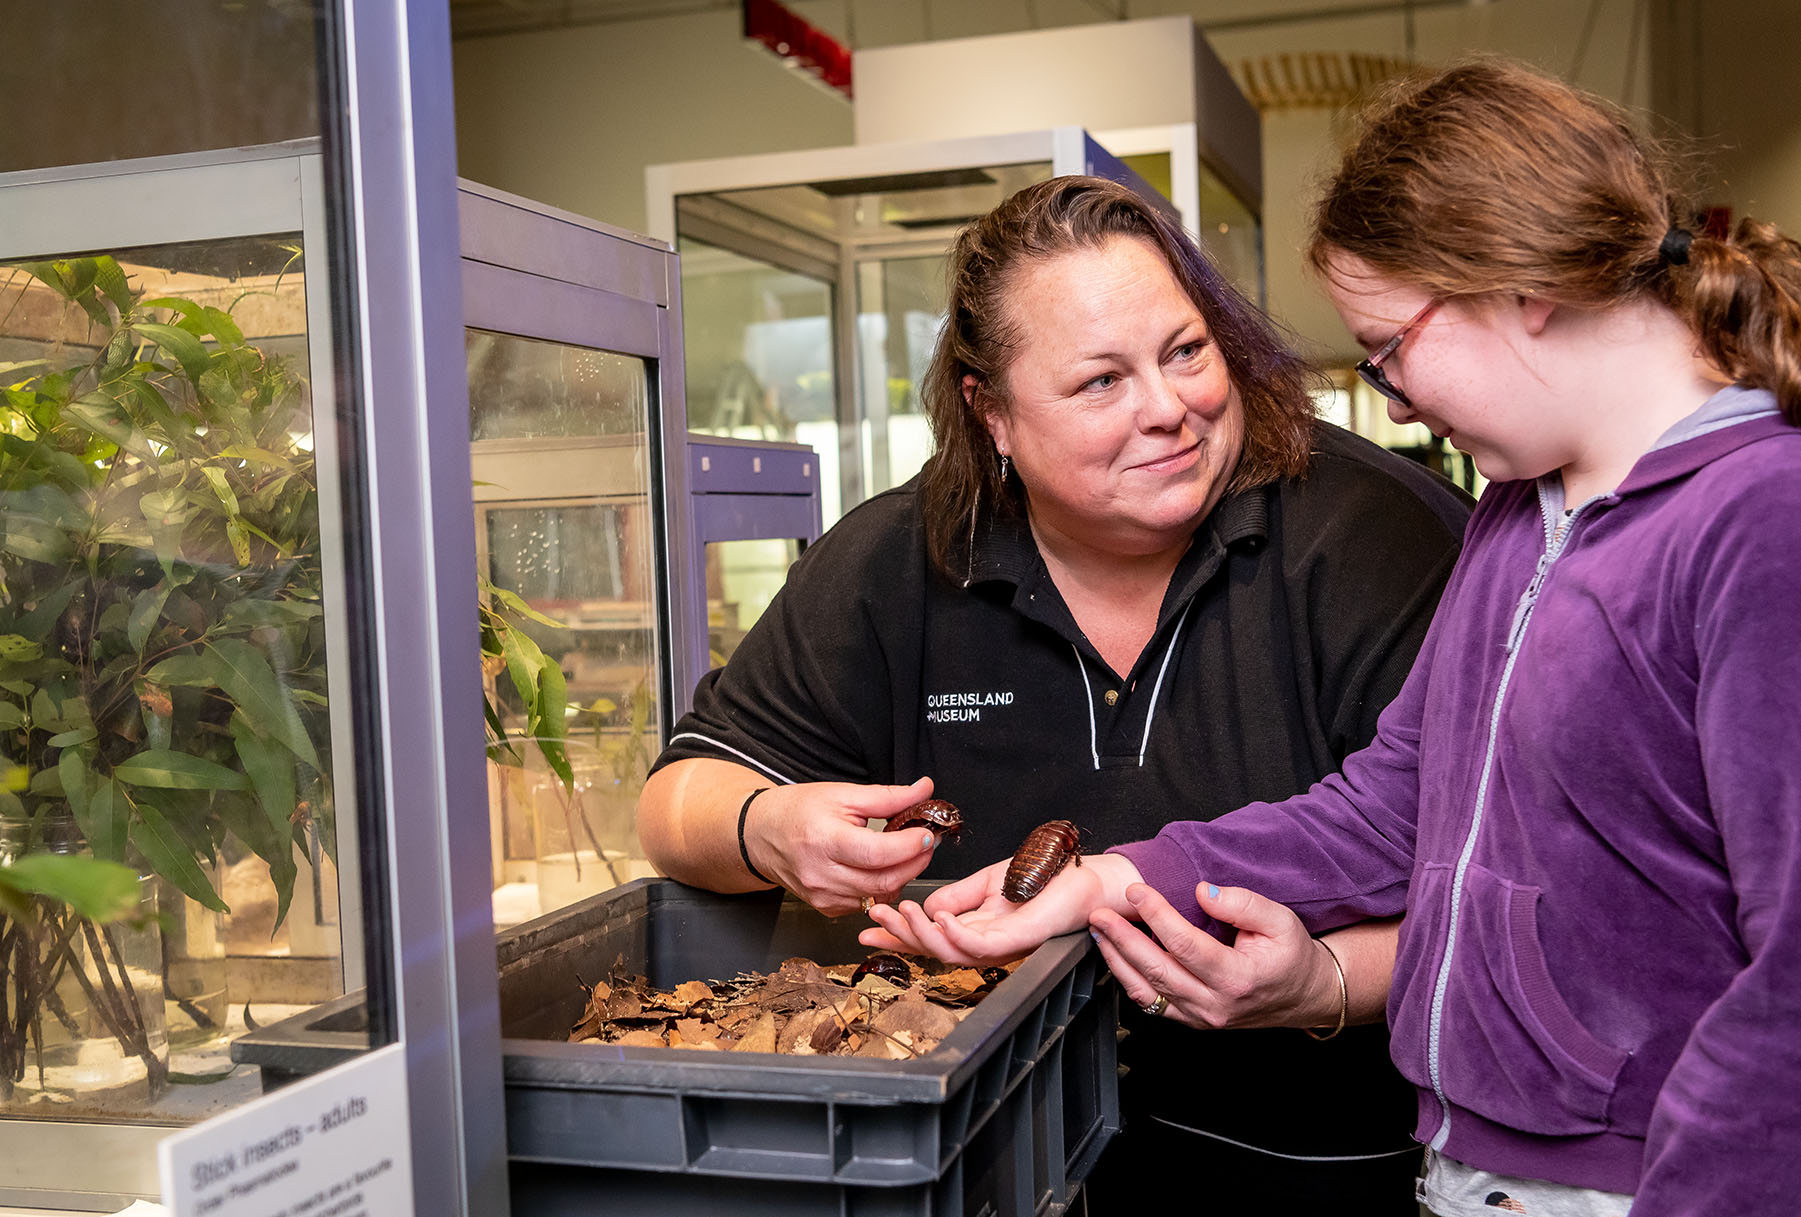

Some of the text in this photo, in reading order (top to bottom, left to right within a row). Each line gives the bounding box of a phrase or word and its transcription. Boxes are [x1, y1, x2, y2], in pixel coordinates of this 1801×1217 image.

[927, 692, 1014, 707] QUEENSLAND
[927, 708, 981, 723] MUSEUM
[192, 1154, 236, 1191] Stick
[243, 1127, 301, 1167] insects
[320, 1096, 367, 1132] adults
